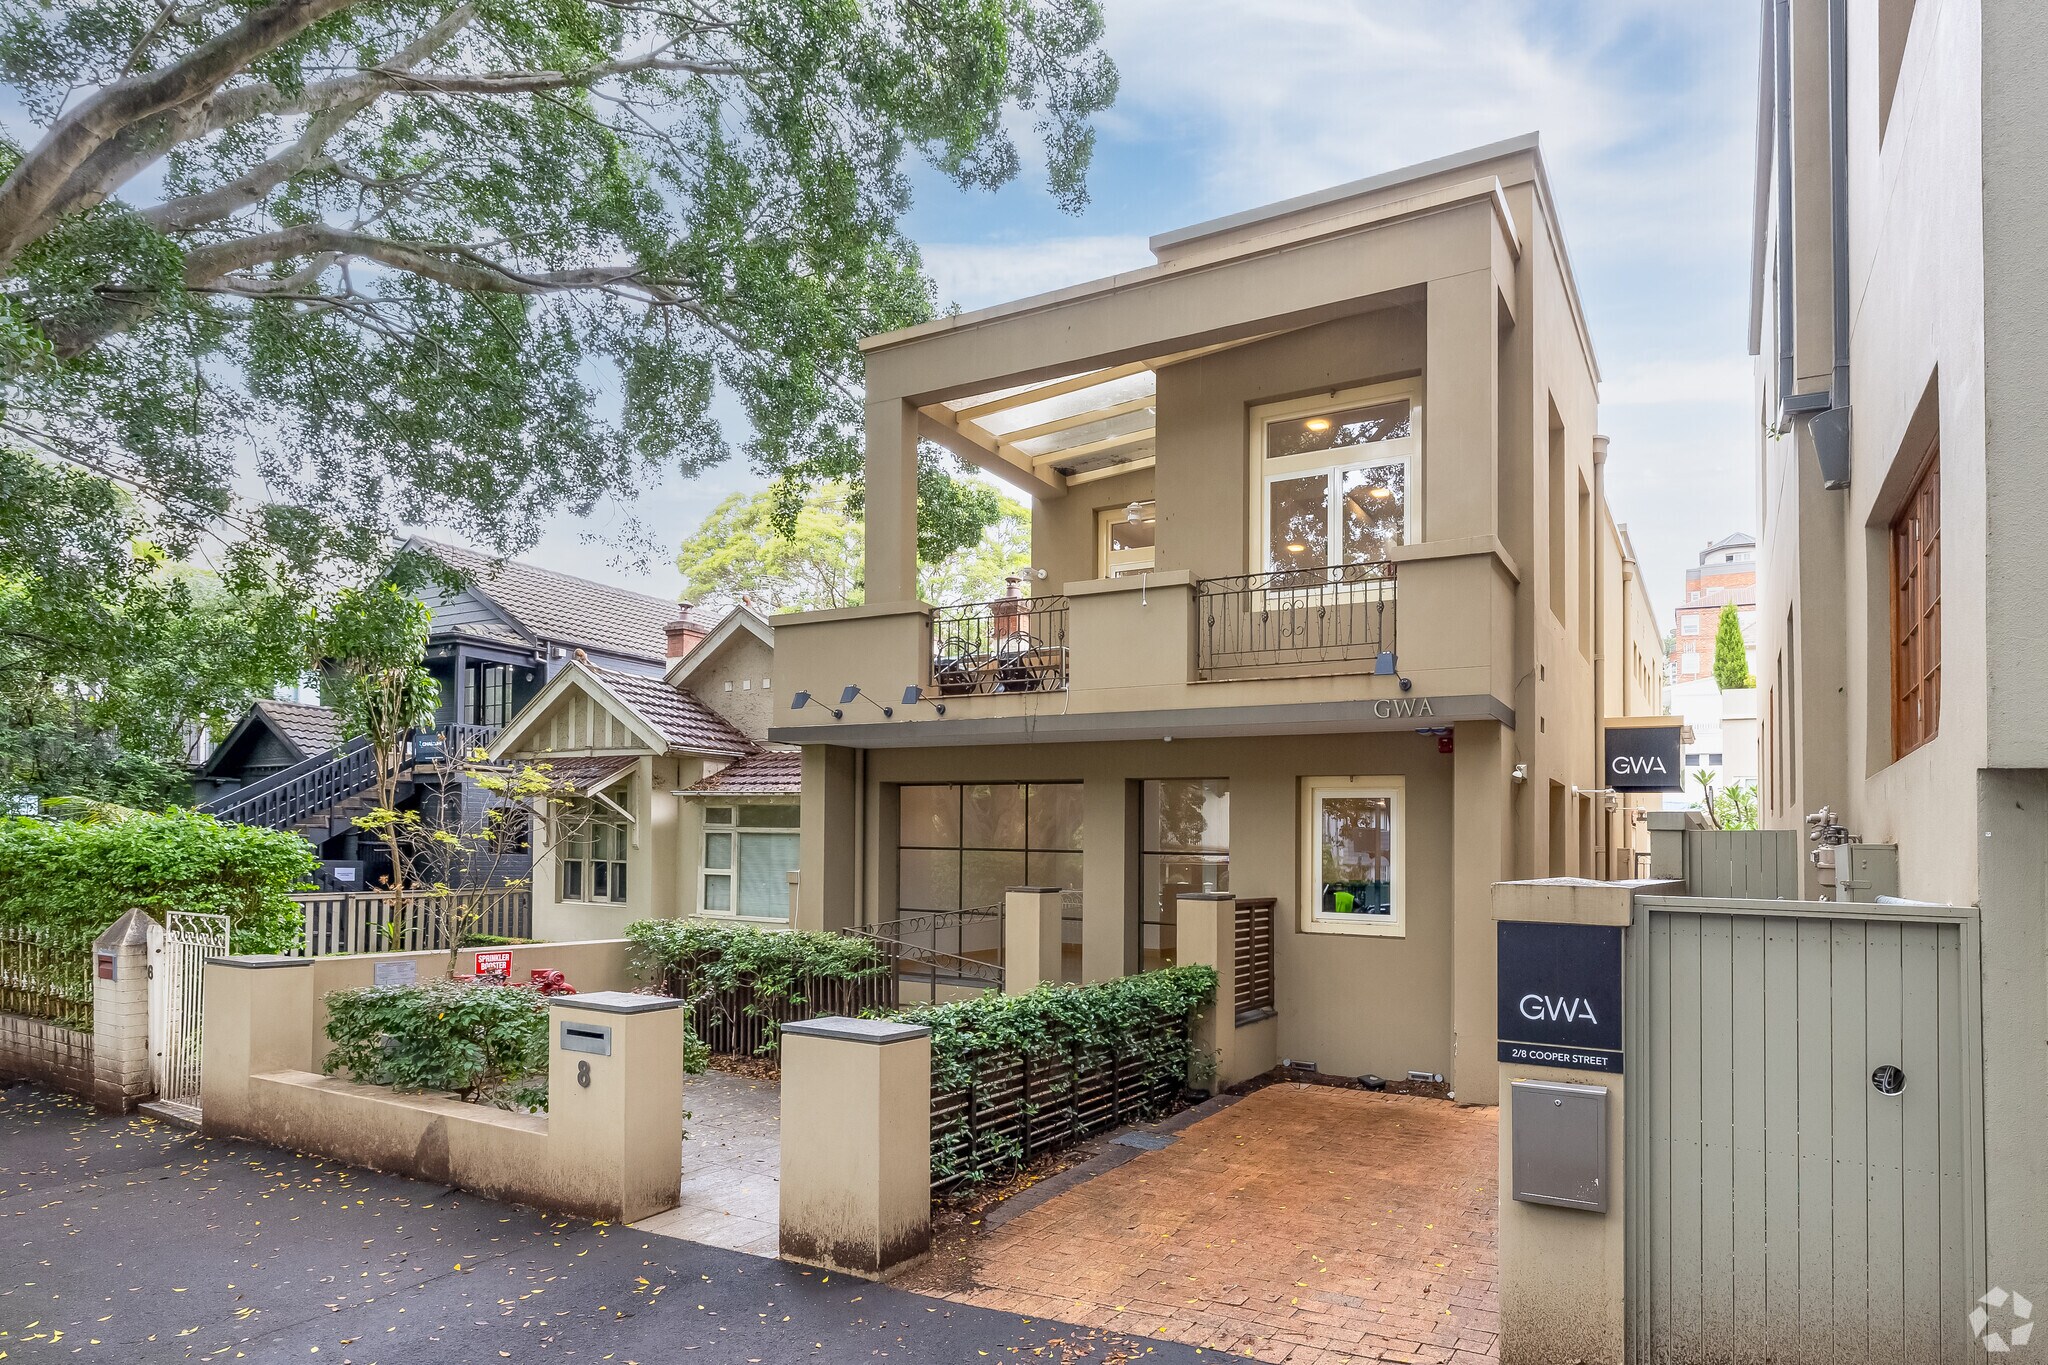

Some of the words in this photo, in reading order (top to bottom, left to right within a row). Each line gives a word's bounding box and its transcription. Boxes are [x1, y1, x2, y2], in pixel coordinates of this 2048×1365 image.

[1373, 697, 1435, 719] GWA
[1611, 756, 1667, 774] GWA
[478, 954, 510, 963] SPRINKLER
[480, 961, 507, 971] BOOSTER
[1519, 994, 1598, 1025] GWA
[1511, 1048, 1527, 1059] 2/8
[1528, 1050, 1571, 1063] COOPER
[1572, 1054, 1609, 1066] STREET
[577, 1060, 591, 1088] 8
